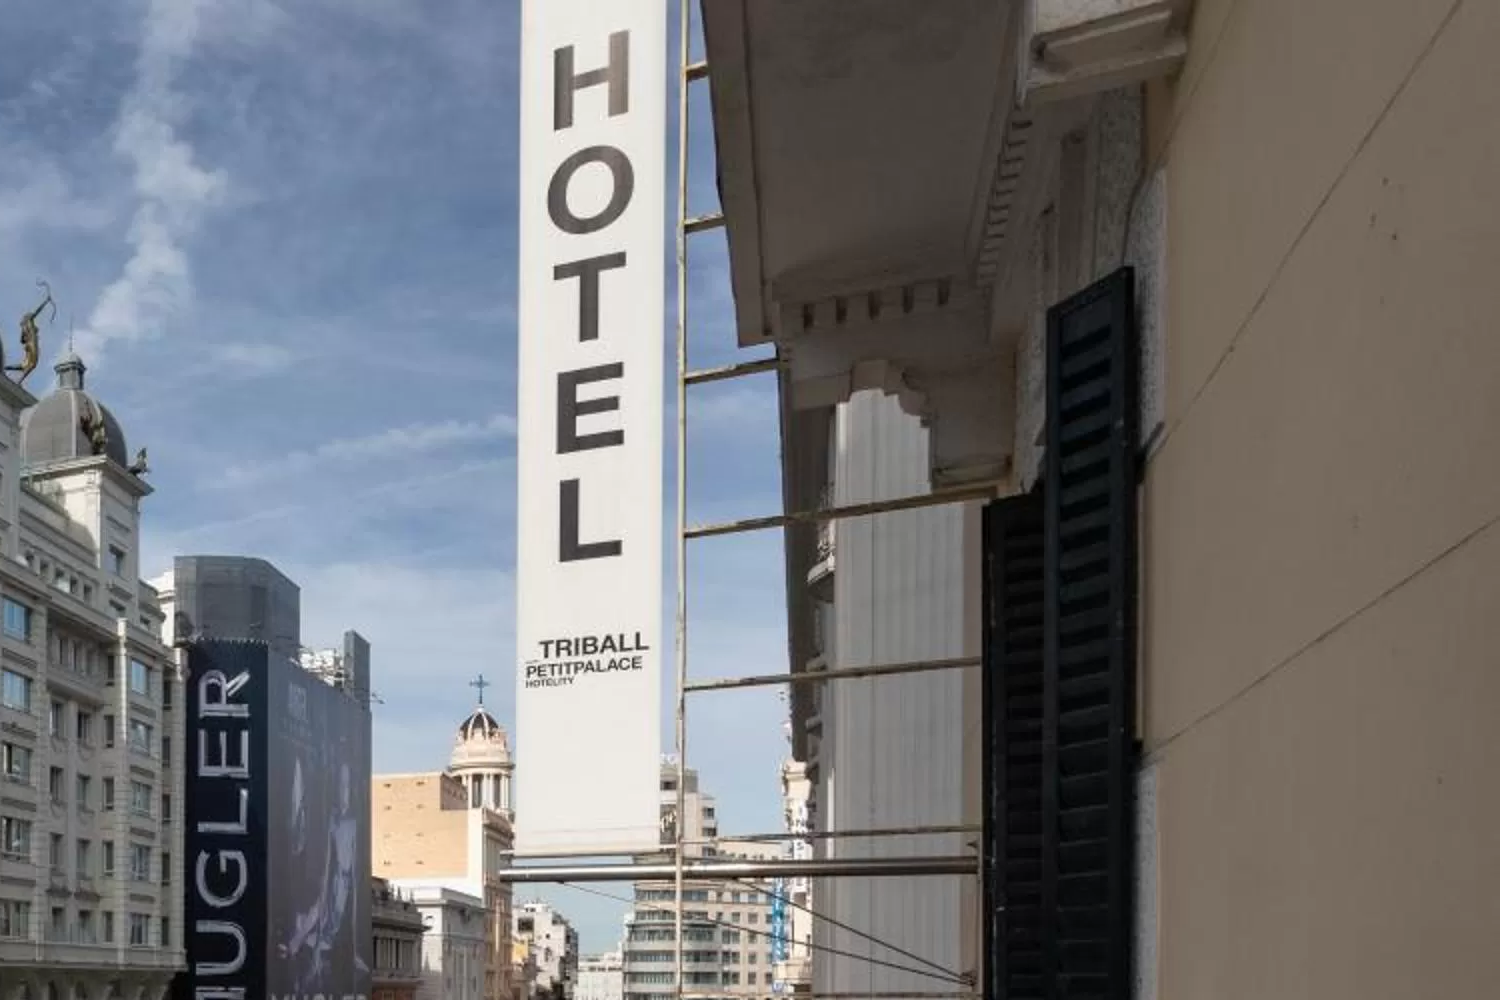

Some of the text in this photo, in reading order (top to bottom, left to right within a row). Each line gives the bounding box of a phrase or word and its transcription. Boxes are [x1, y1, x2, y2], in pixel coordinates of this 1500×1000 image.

[547, 29, 635, 562] HOTEL
[538, 631, 650, 659] TRIBALL
[525, 655, 643, 679] PETITPALACE
